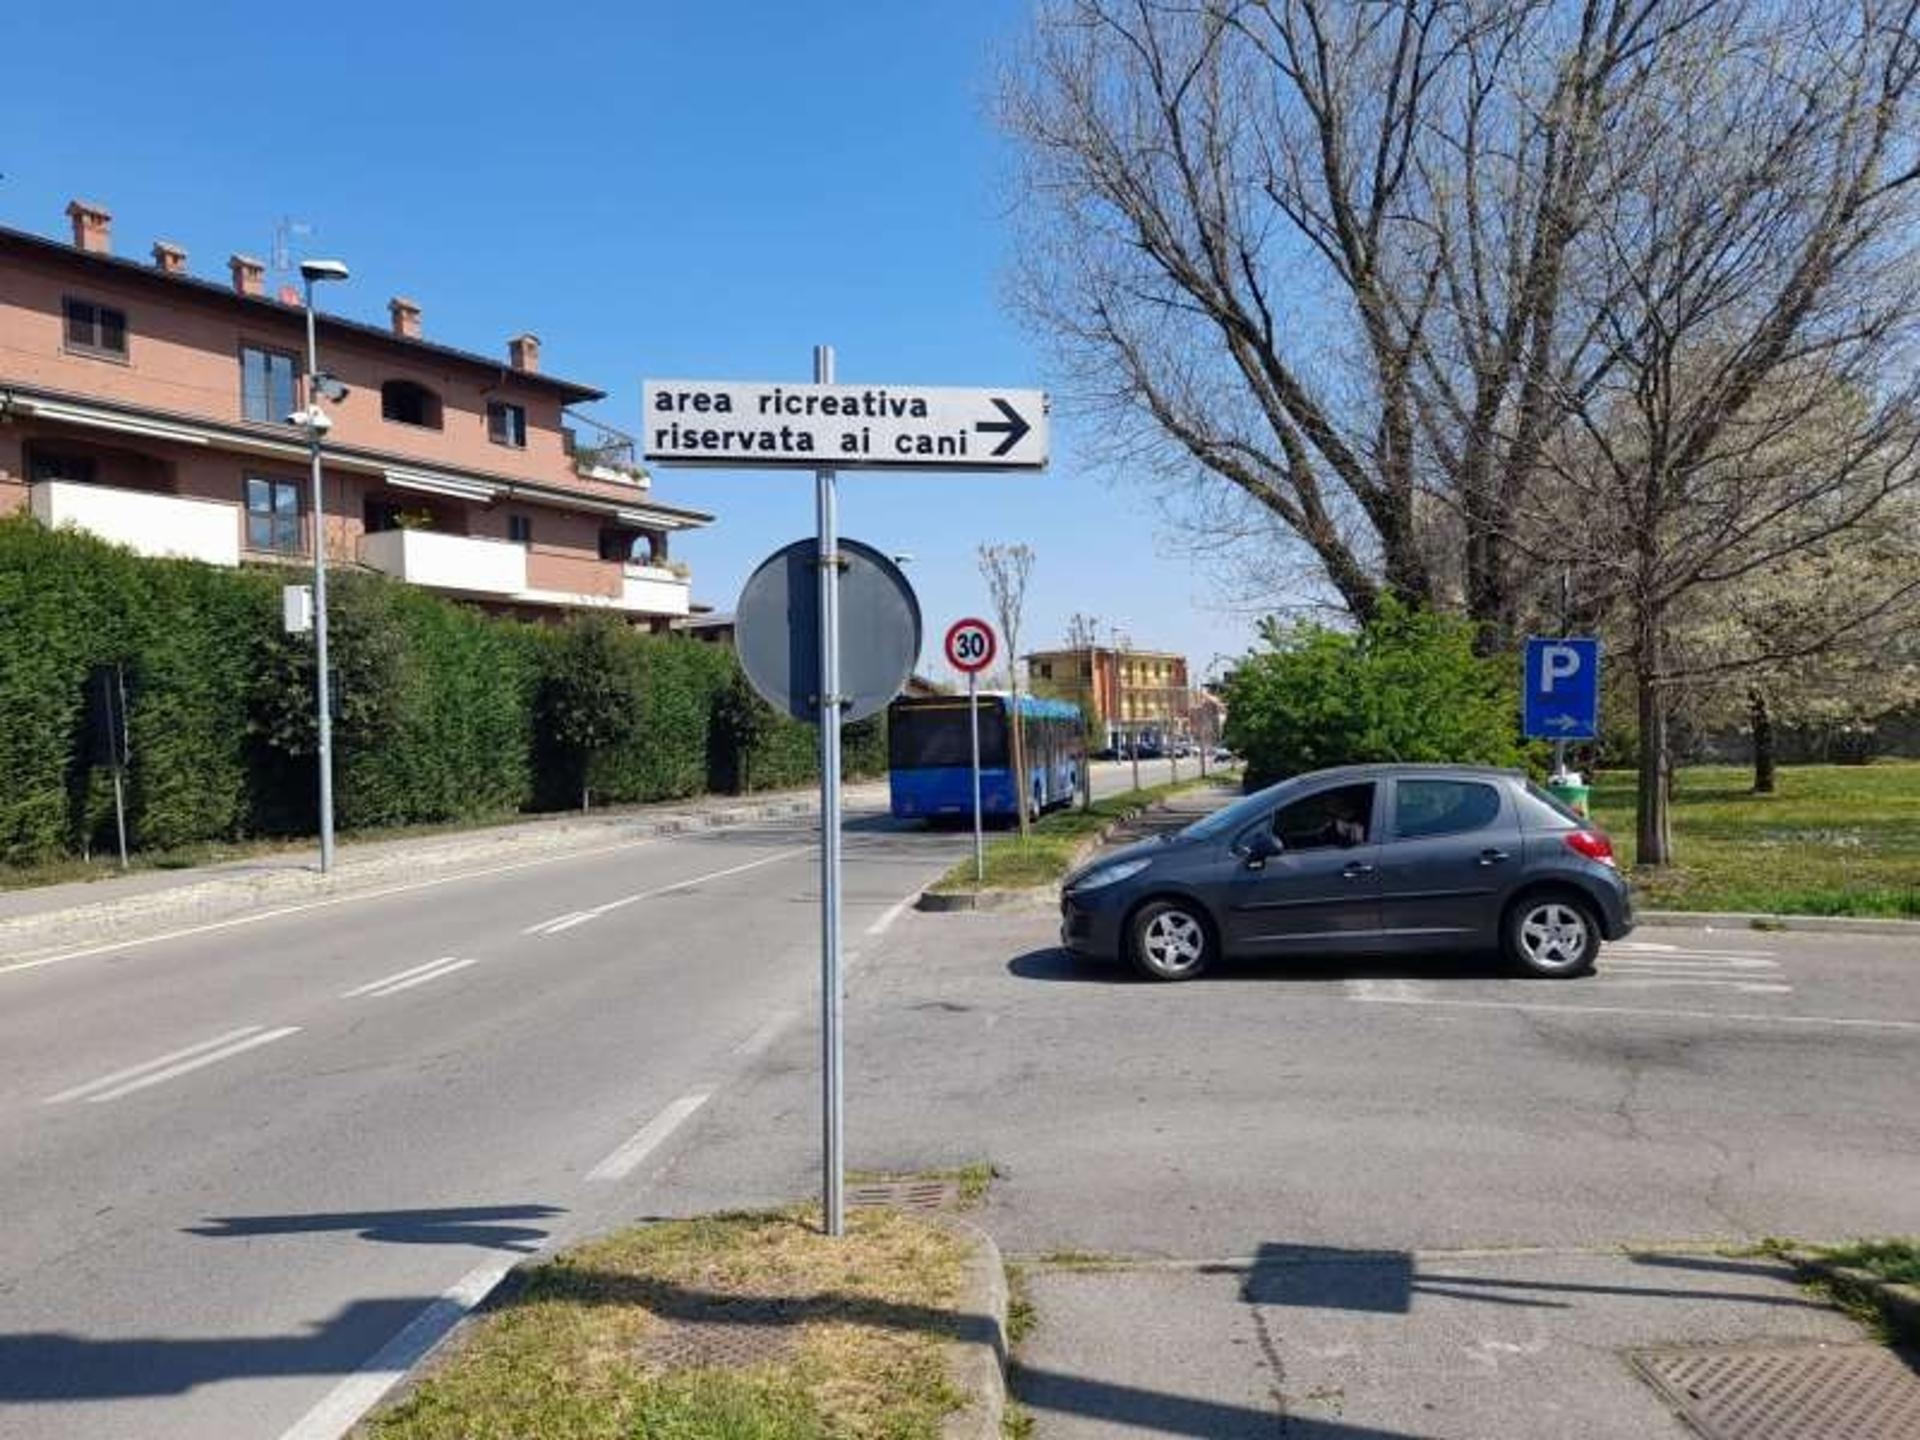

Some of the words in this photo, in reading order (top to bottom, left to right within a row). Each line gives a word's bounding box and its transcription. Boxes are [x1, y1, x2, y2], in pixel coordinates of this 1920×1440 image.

[655, 391, 733, 414] area
[759, 388, 928, 418] ricreativa
[655, 422, 815, 452] riservata
[840, 426, 870, 453] ai
[895, 430, 967, 456] cani
[956, 632, 985, 659] 30
[1541, 646, 1580, 692] P
